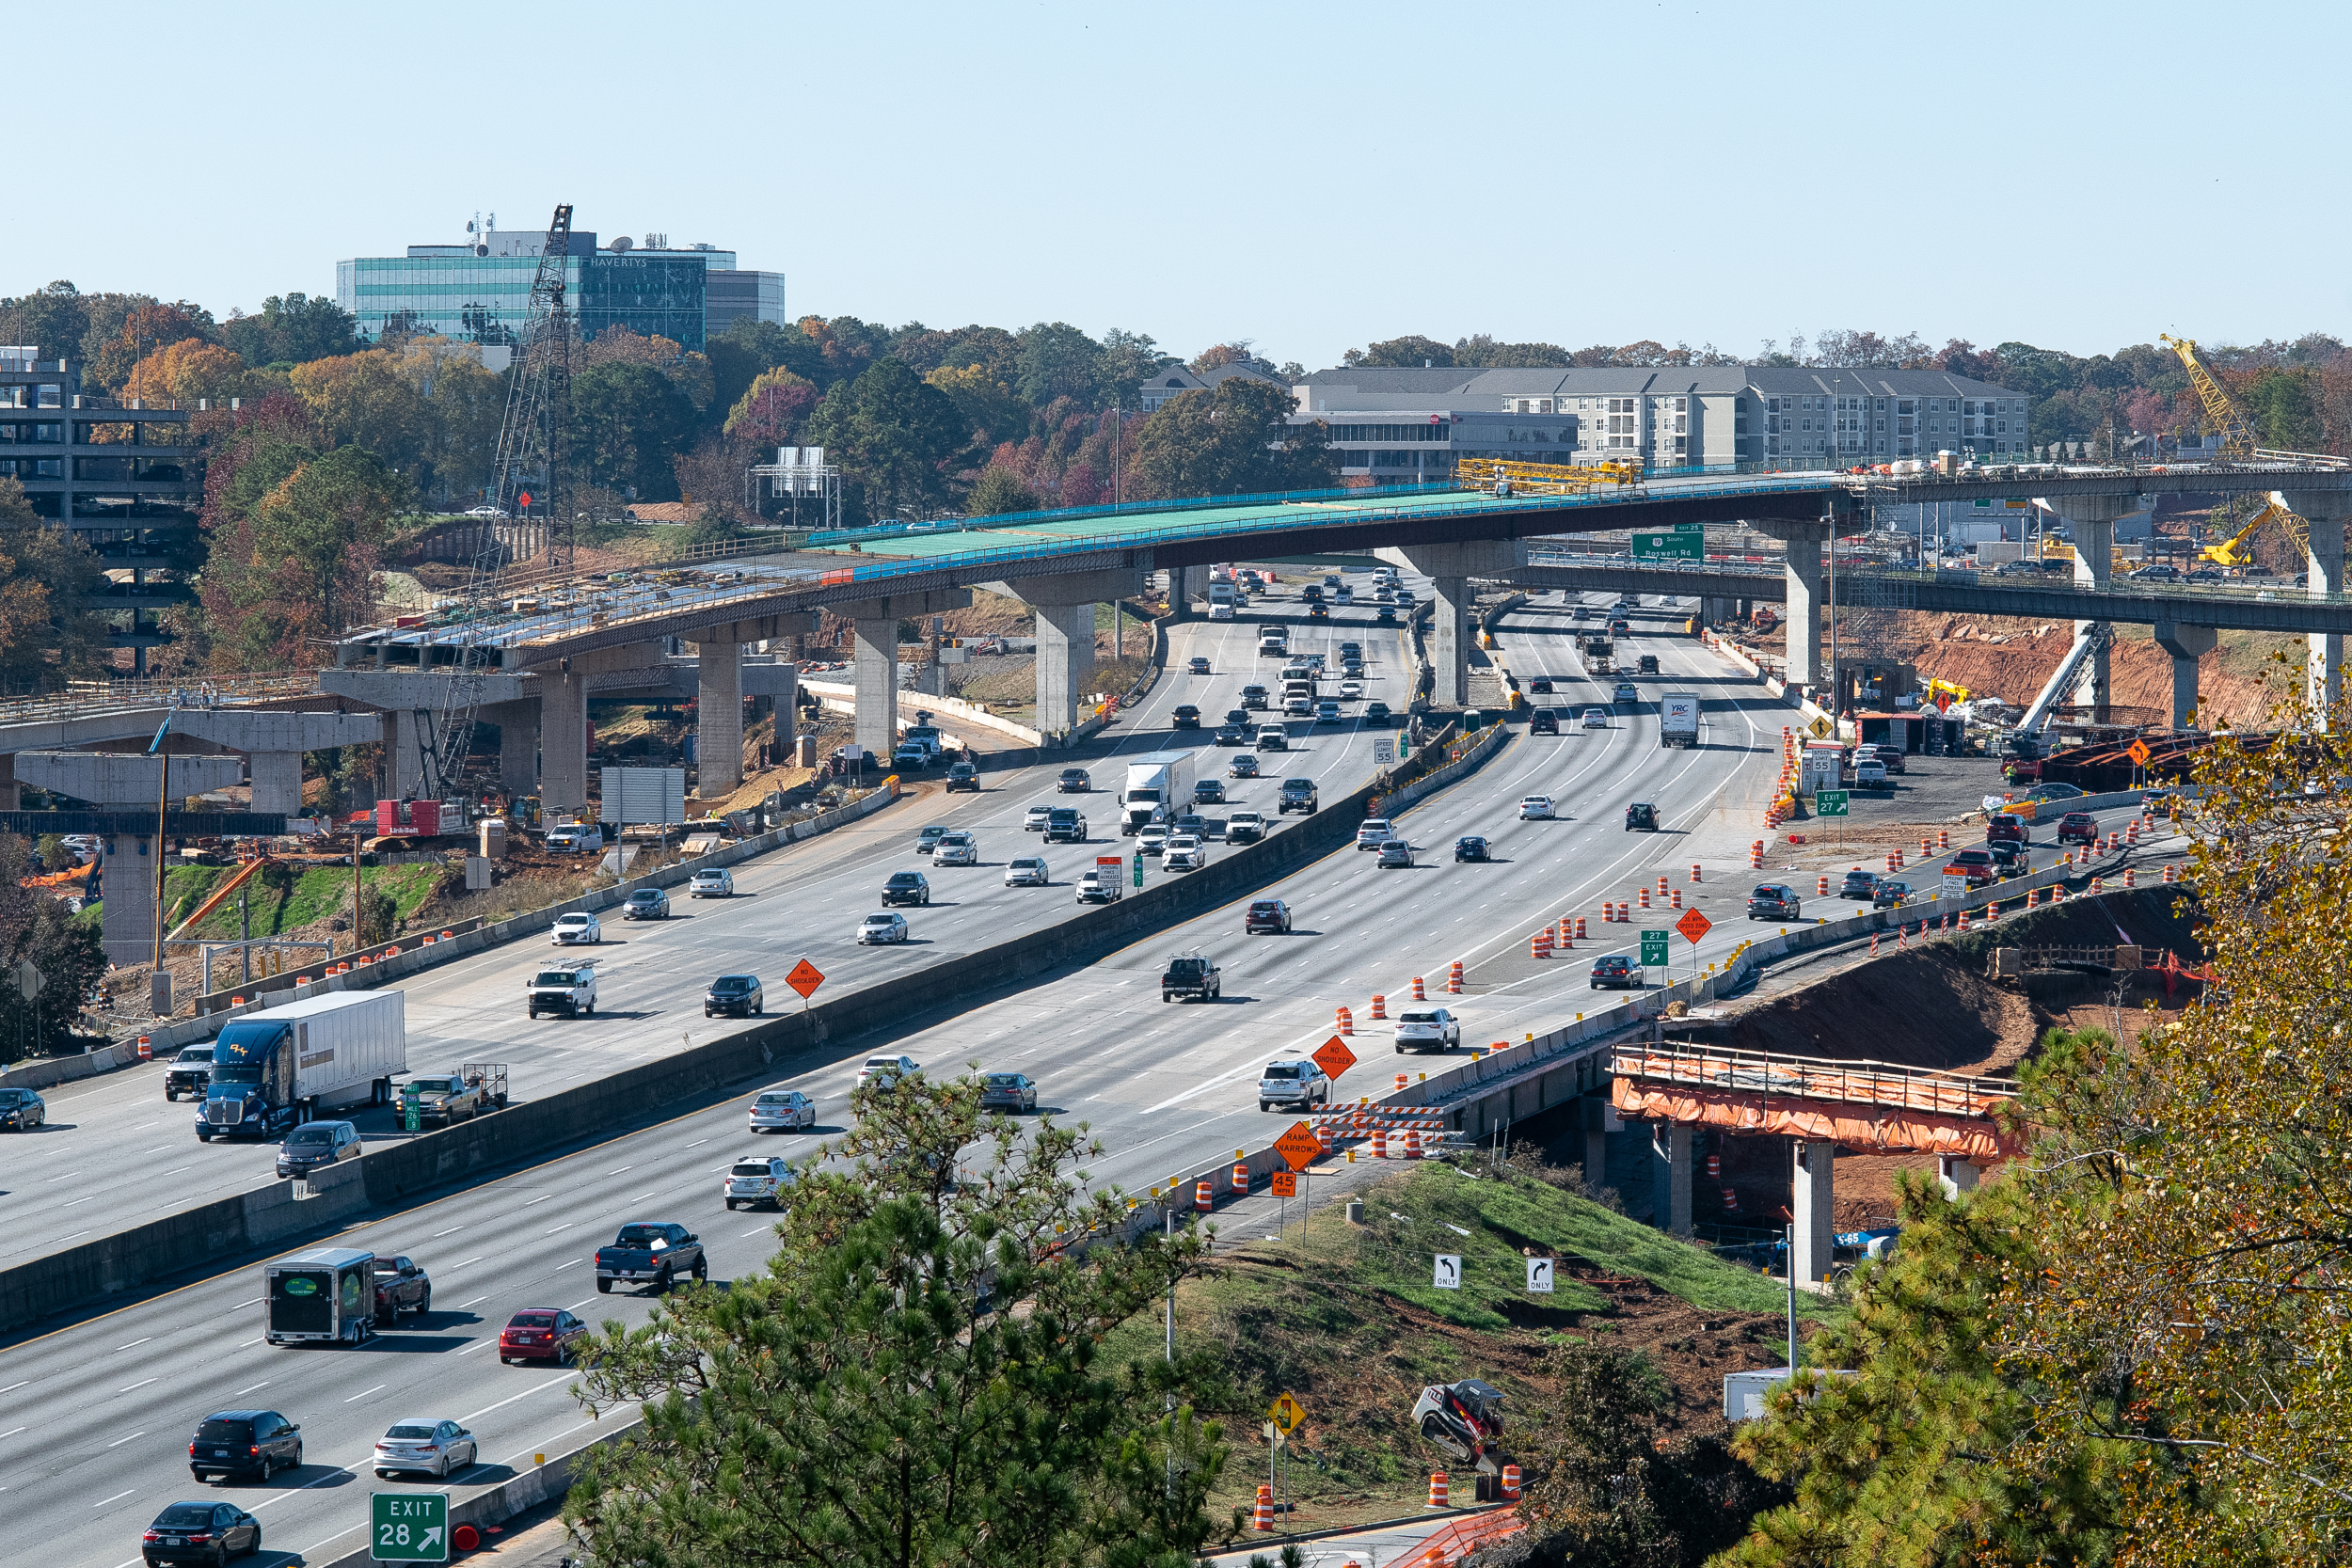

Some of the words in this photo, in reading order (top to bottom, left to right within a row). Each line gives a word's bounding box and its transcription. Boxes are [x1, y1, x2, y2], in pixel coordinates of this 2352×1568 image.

[591, 258, 647, 267] HAVERTYS
[1820, 802, 1833, 812] 27
[1317, 1055, 1351, 1065] SHOULDER
[1286, 1132, 1311, 1142] RAMP
[1278, 1144, 1317, 1154] NARROWS
[1274, 1175, 1294, 1187] 45
[1438, 1277, 1456, 1286] ONLY
[390, 1501, 432, 1516] EXIT
[379, 1524, 410, 1545] 28
